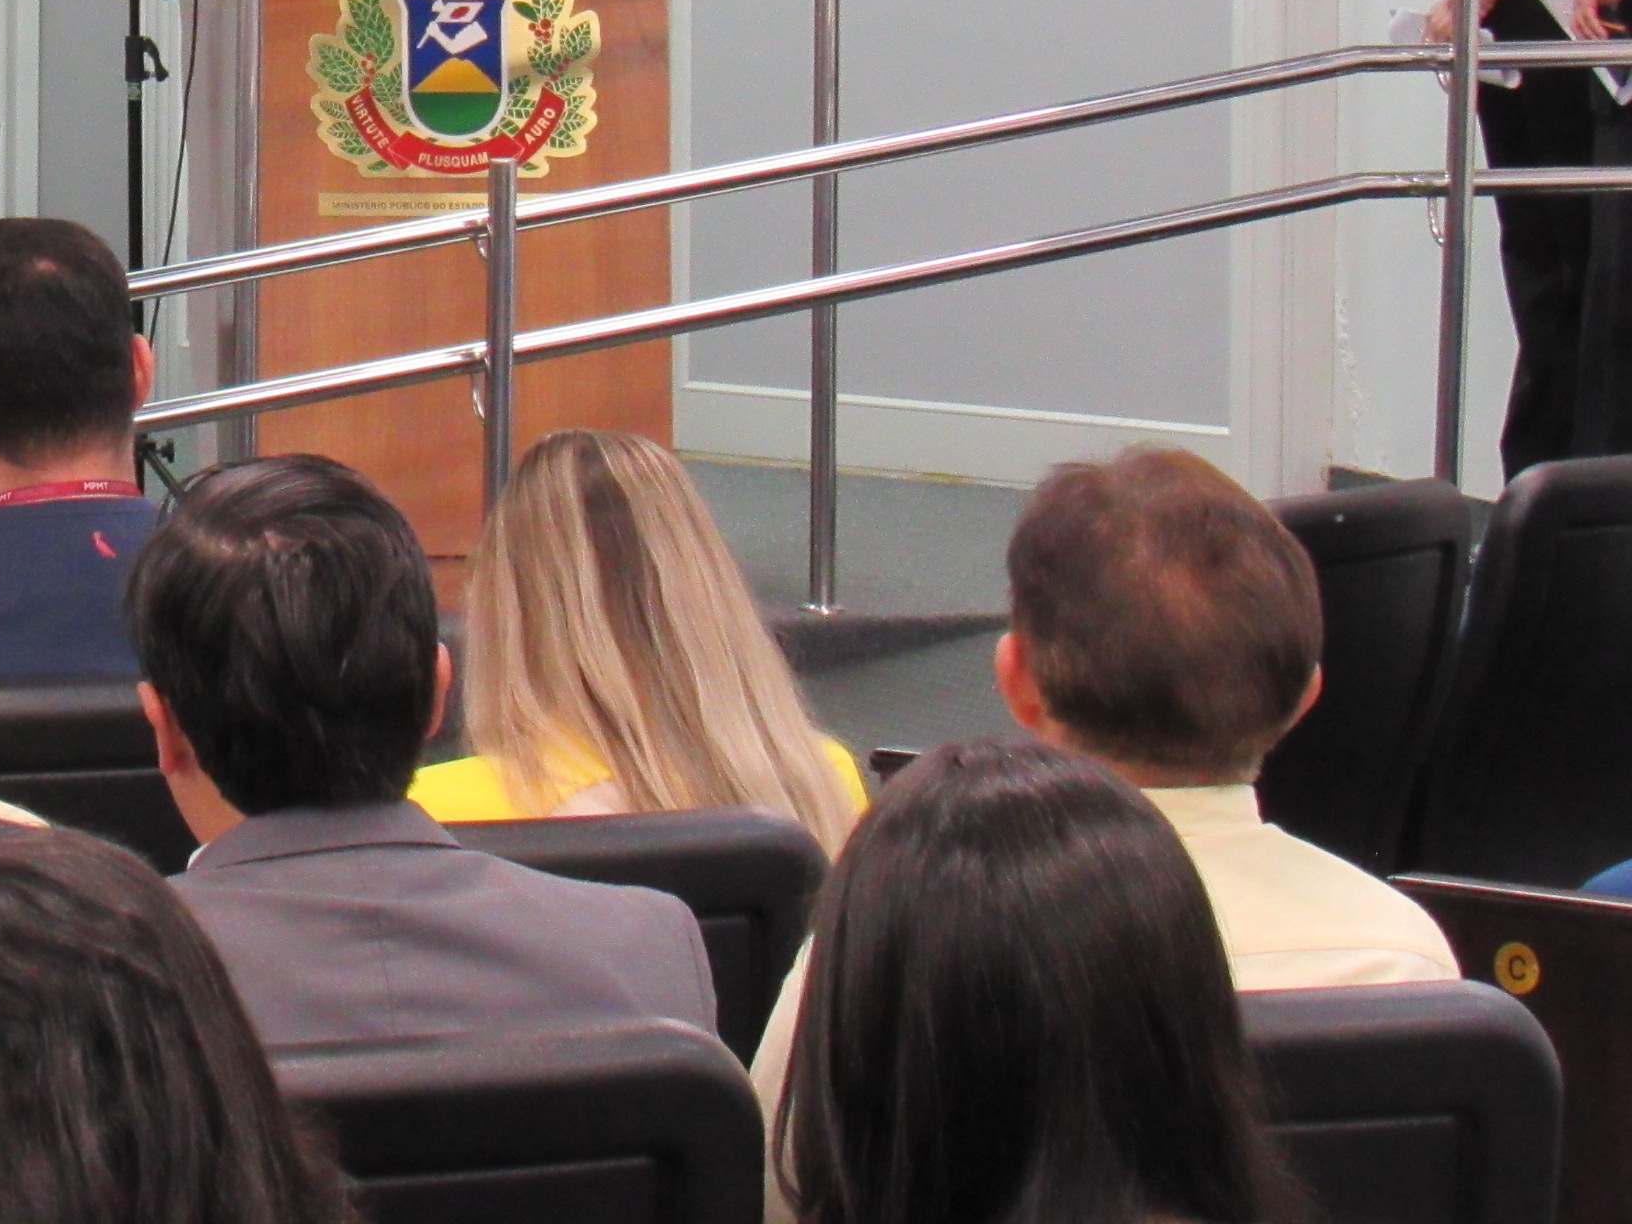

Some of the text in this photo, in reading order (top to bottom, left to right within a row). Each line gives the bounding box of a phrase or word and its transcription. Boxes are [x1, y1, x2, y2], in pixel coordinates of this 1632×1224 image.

[351, 95, 556, 168] VIRTUTE PLUSQUAM AURO
[84, 481, 109, 491] MPMT
[1508, 954, 1526, 981] C
